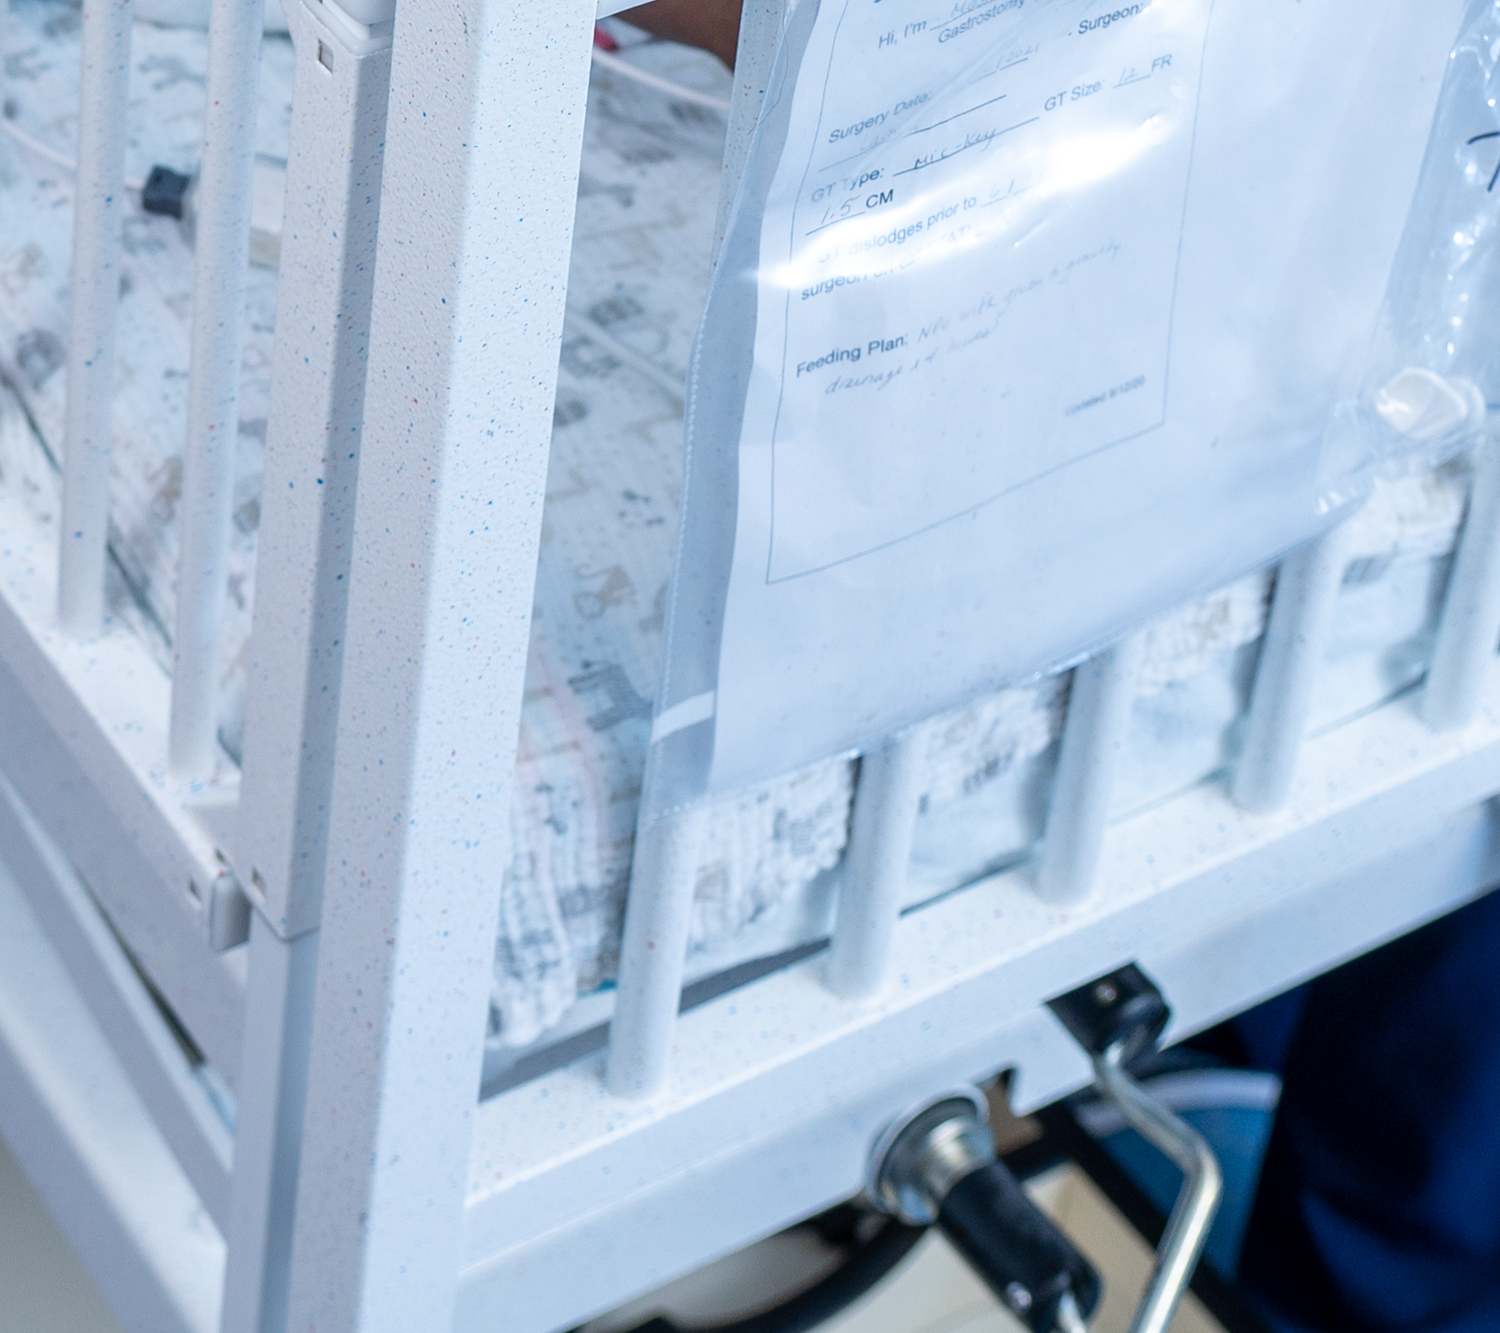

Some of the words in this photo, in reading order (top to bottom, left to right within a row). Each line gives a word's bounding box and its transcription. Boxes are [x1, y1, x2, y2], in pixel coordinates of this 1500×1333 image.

[877, 28, 898, 50] Hi,
[903, 17, 928, 39] I'm
[827, 110, 891, 145] Surgery
[1077, 0, 1148, 36] Surgeon:
[811, 183, 838, 203] GT
[1043, 93, 1068, 113] GT
[1070, 78, 1107, 101] Size:
[1150, 53, 1174, 74] FR
[848, 221, 924, 256] dislodges
[926, 204, 961, 231] prior
[963, 195, 978, 210] to
[865, 190, 895, 210] CM
[796, 346, 862, 378] Feeding
[867, 333, 910, 357] Plan:
